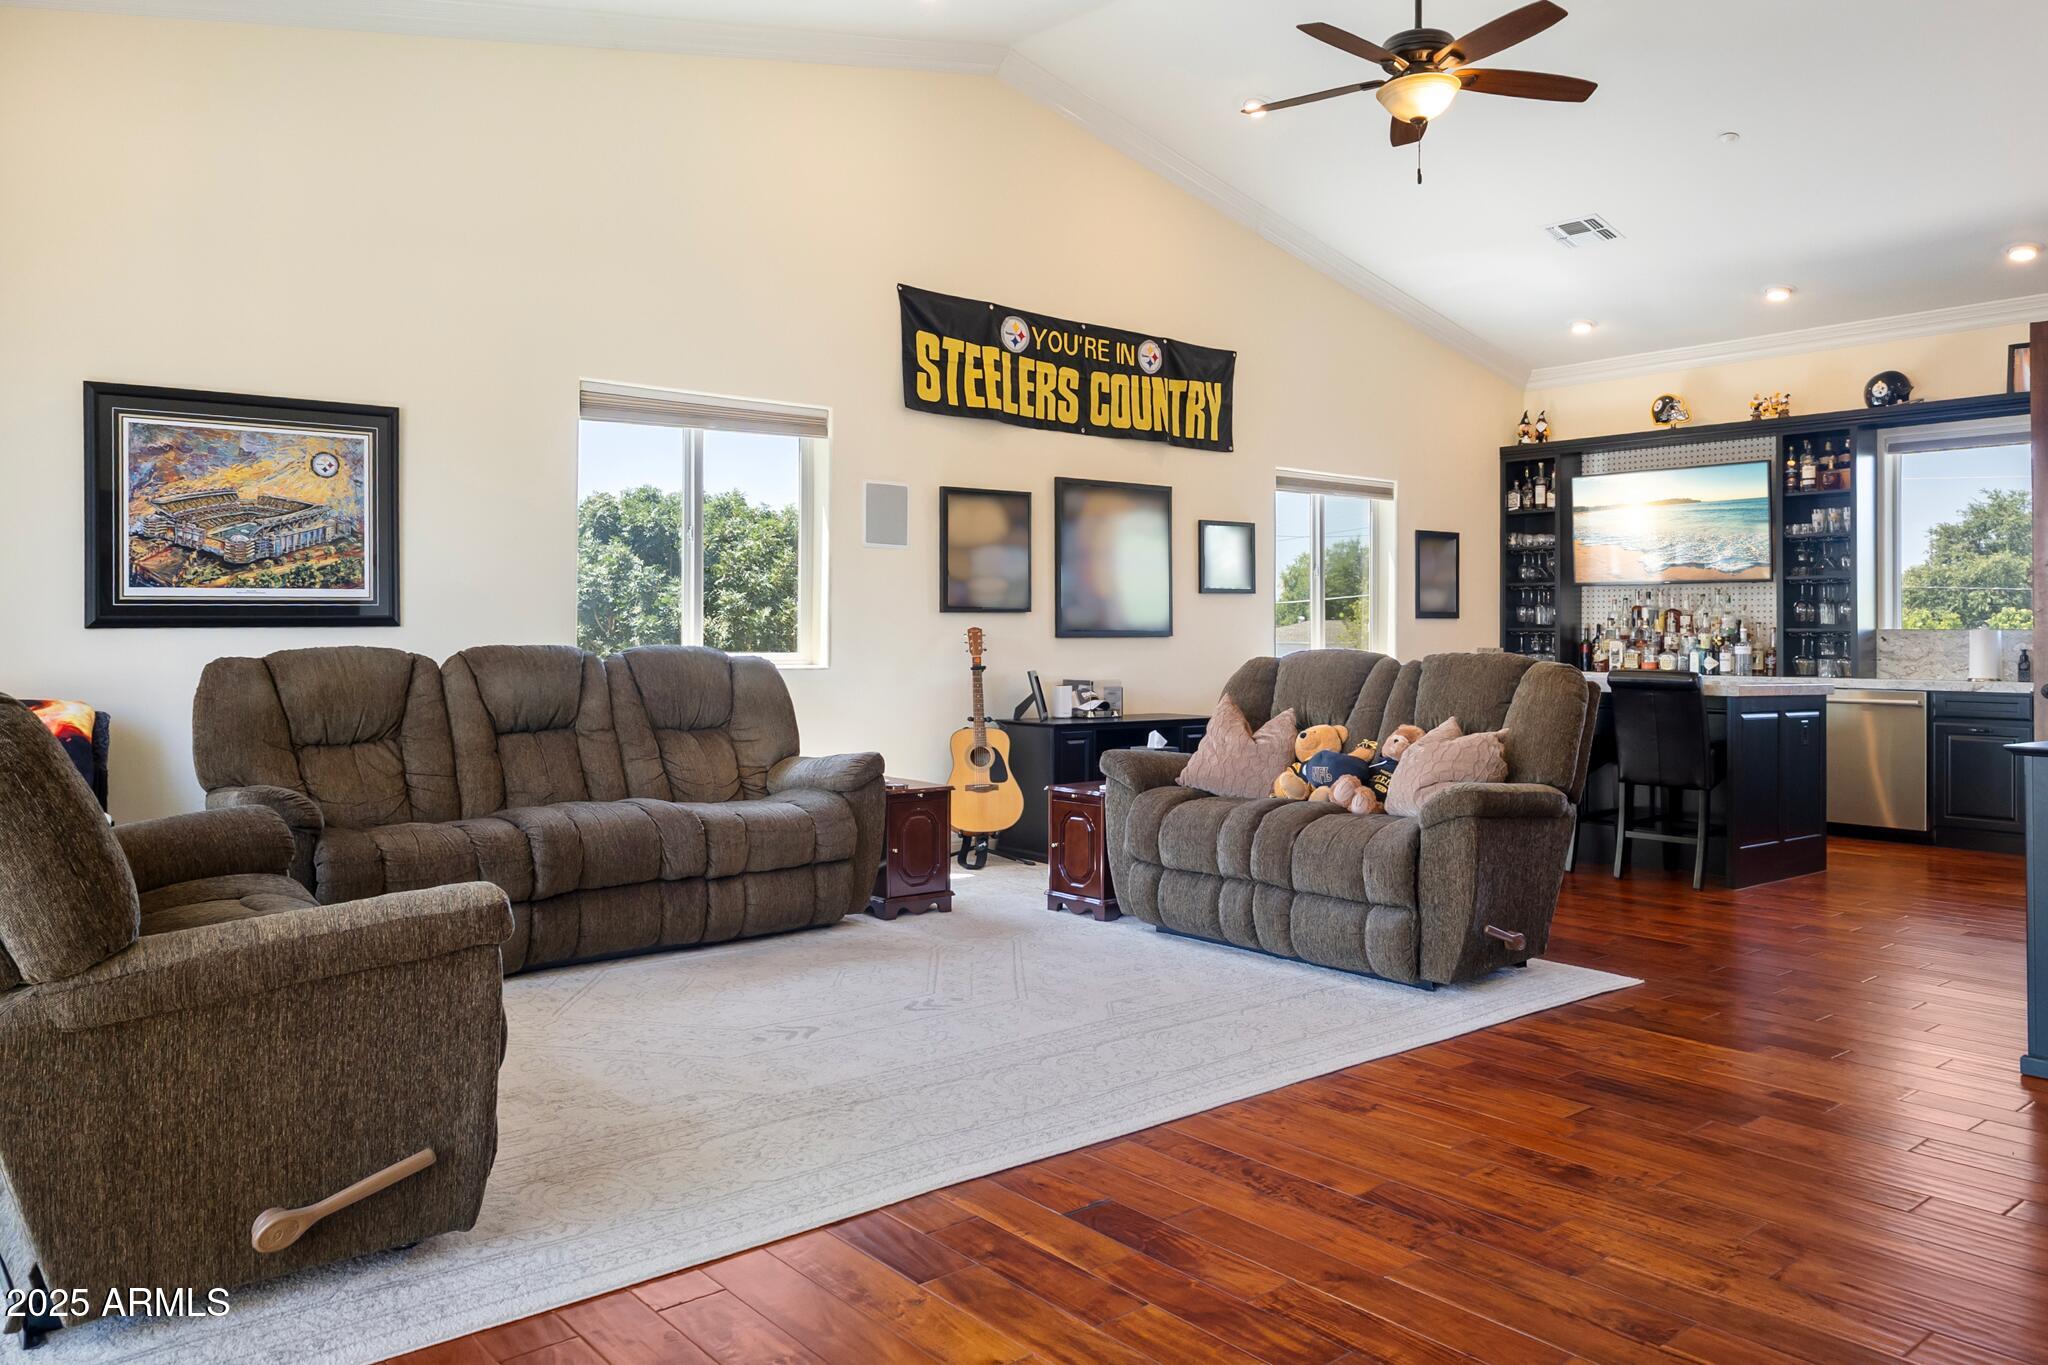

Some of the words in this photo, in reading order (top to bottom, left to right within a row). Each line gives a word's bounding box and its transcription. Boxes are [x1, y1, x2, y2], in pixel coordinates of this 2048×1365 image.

[1031, 326, 1111, 360] YOU'RE
[1116, 342, 1135, 367] IN
[915, 329, 1080, 424] STEELERS
[1089, 371, 1222, 441] COUNTRY
